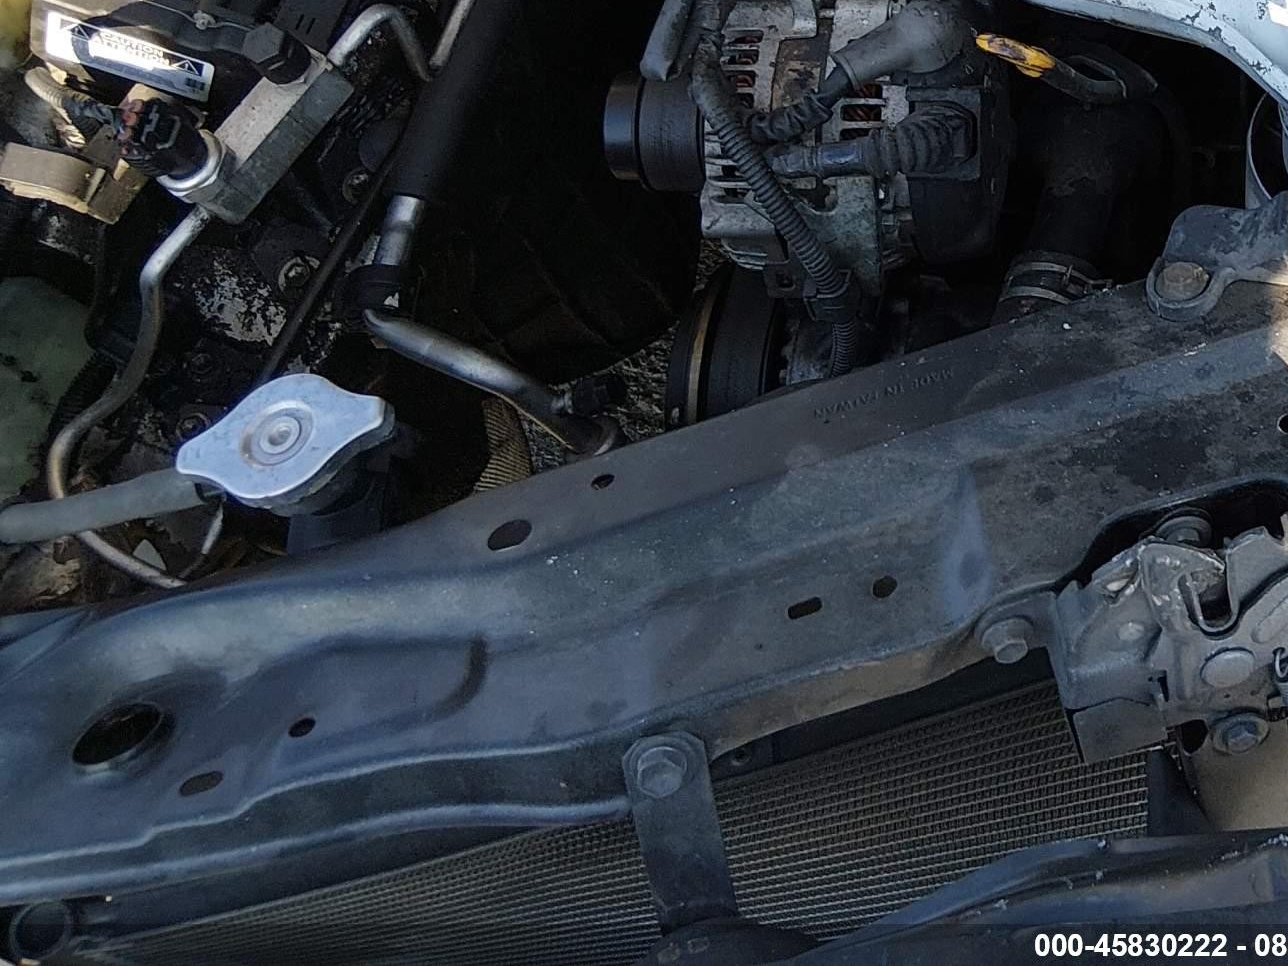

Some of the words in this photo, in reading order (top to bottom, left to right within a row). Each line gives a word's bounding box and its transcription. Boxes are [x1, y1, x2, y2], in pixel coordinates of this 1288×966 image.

[102, 32, 164, 59] CAUTION
[884, 384, 904, 396] IN
[813, 390, 880, 419] TAIWAN
